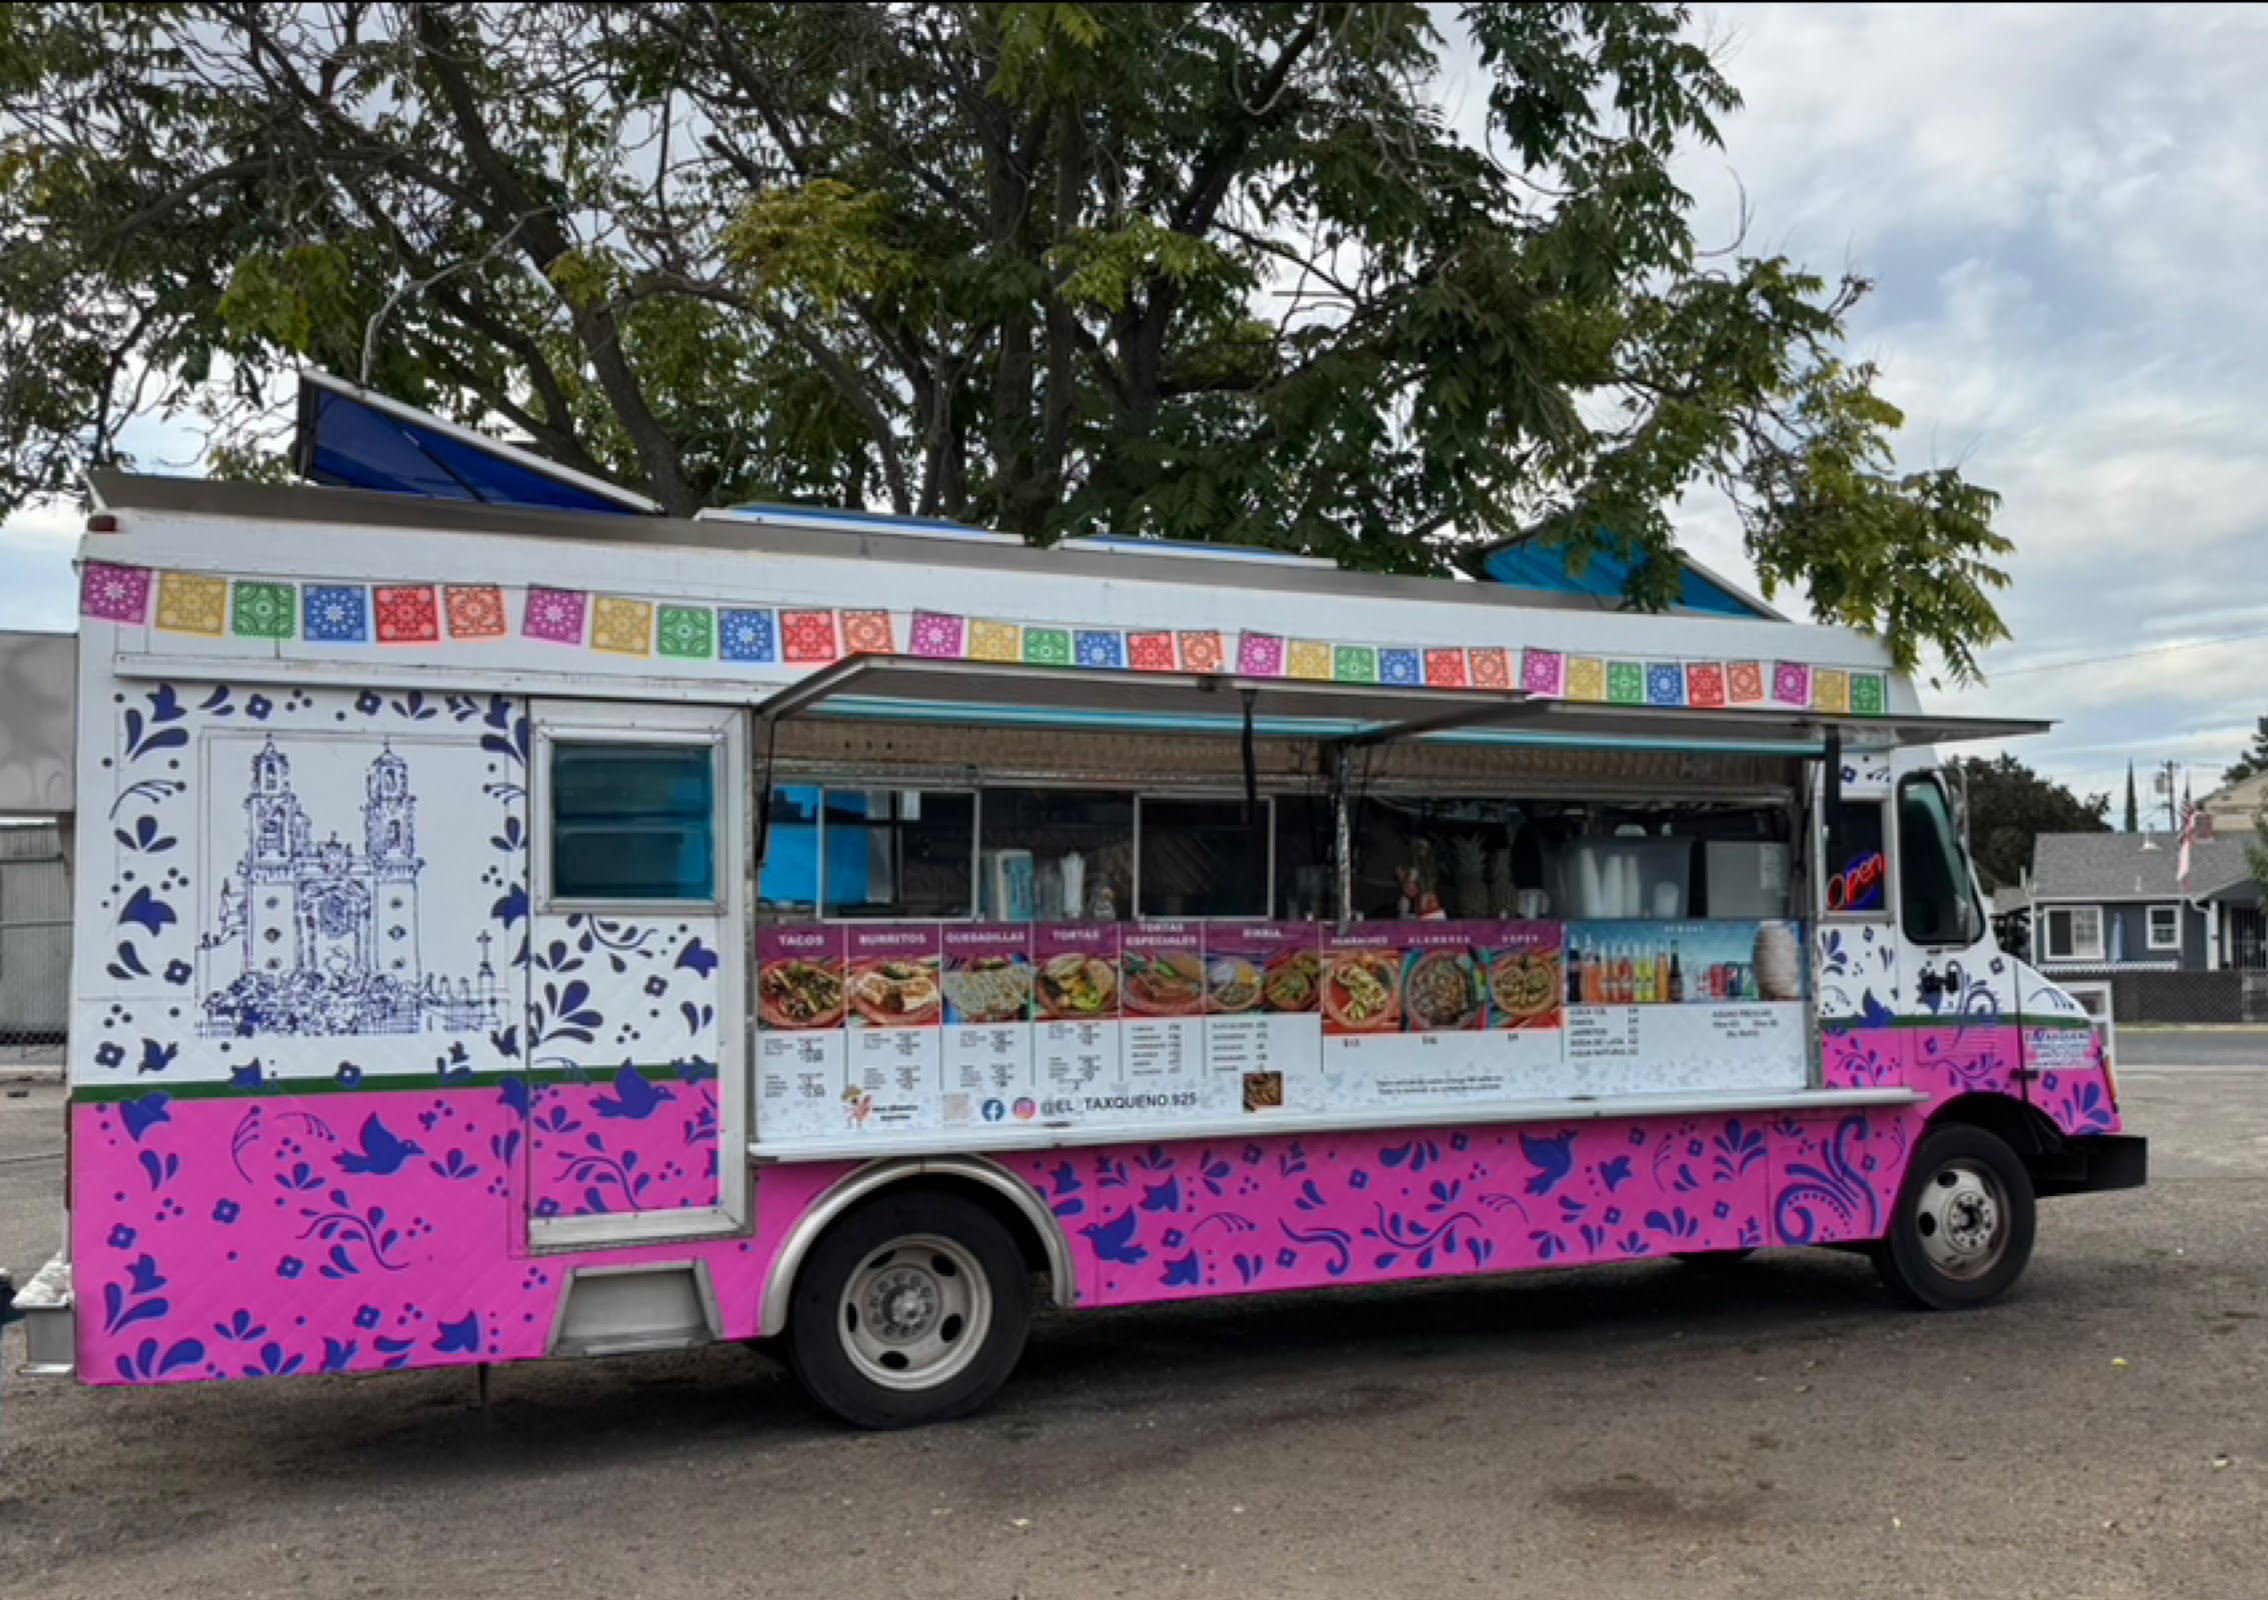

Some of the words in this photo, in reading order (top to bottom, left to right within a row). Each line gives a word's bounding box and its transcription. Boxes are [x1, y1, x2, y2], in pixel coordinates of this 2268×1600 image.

[1827, 852, 1888, 911] Open
[1139, 922, 1185, 933] TORTAS
[1242, 928, 1283, 939] BIRRIA
[778, 934, 825, 947] TACOS
[858, 932, 927, 945] BURRITOS
[944, 931, 1026, 944] QUESADILLAS
[1052, 929, 1101, 941] TORTAS
[1125, 935, 1198, 947] ESPECIALES
